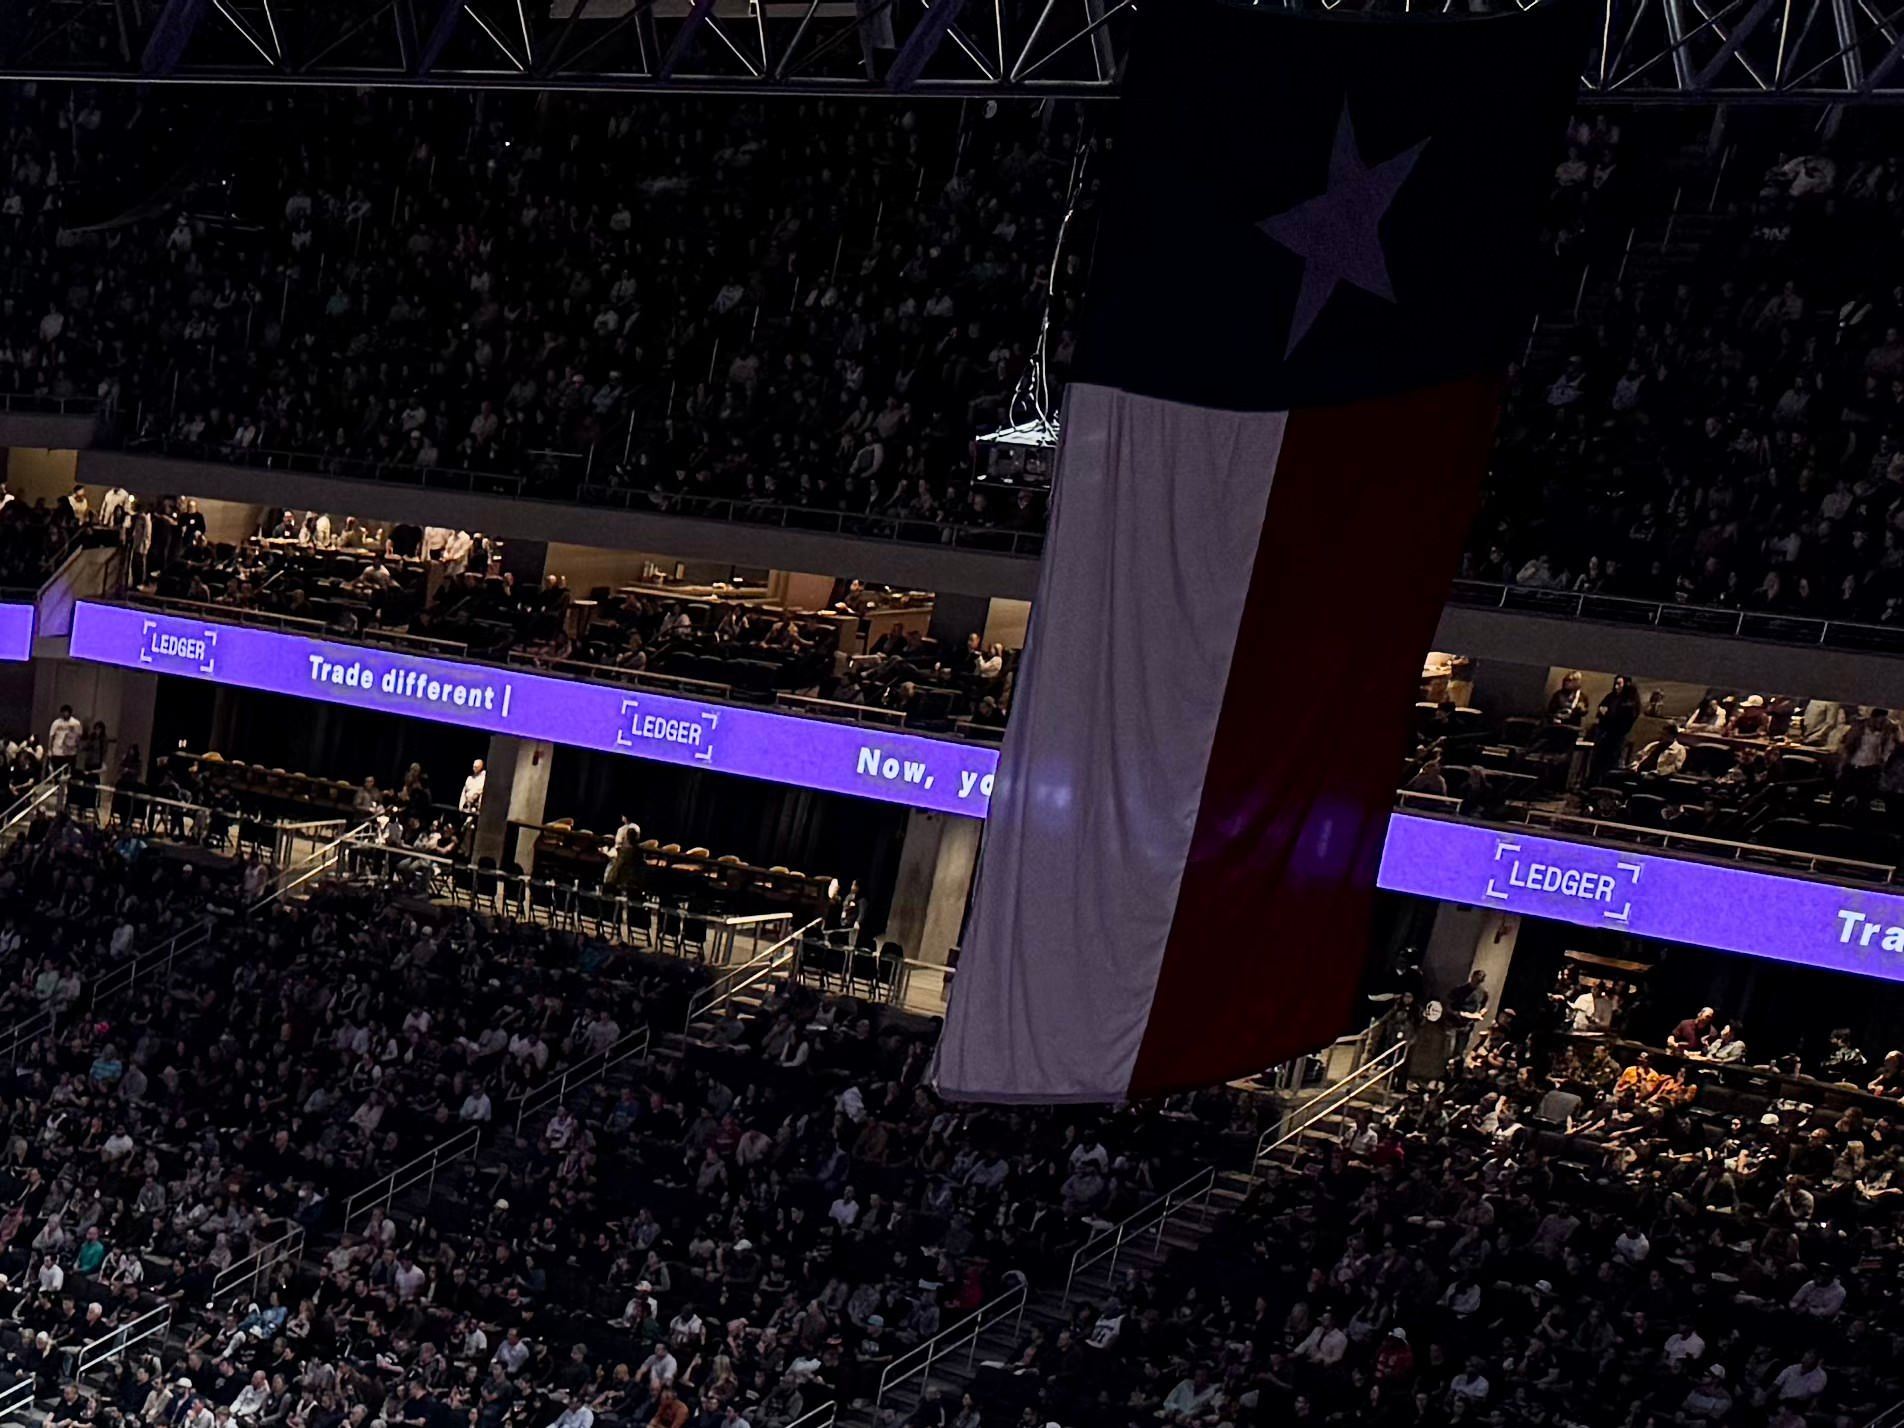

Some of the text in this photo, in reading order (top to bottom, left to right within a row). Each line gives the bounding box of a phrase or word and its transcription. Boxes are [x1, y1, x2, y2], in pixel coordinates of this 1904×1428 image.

[150, 632, 206, 662] LEDGER
[308, 654, 494, 712] Trade different
[631, 711, 703, 748] LEDGER
[856, 746, 936, 790] Now,
[1509, 859, 1617, 904] LEDGER
